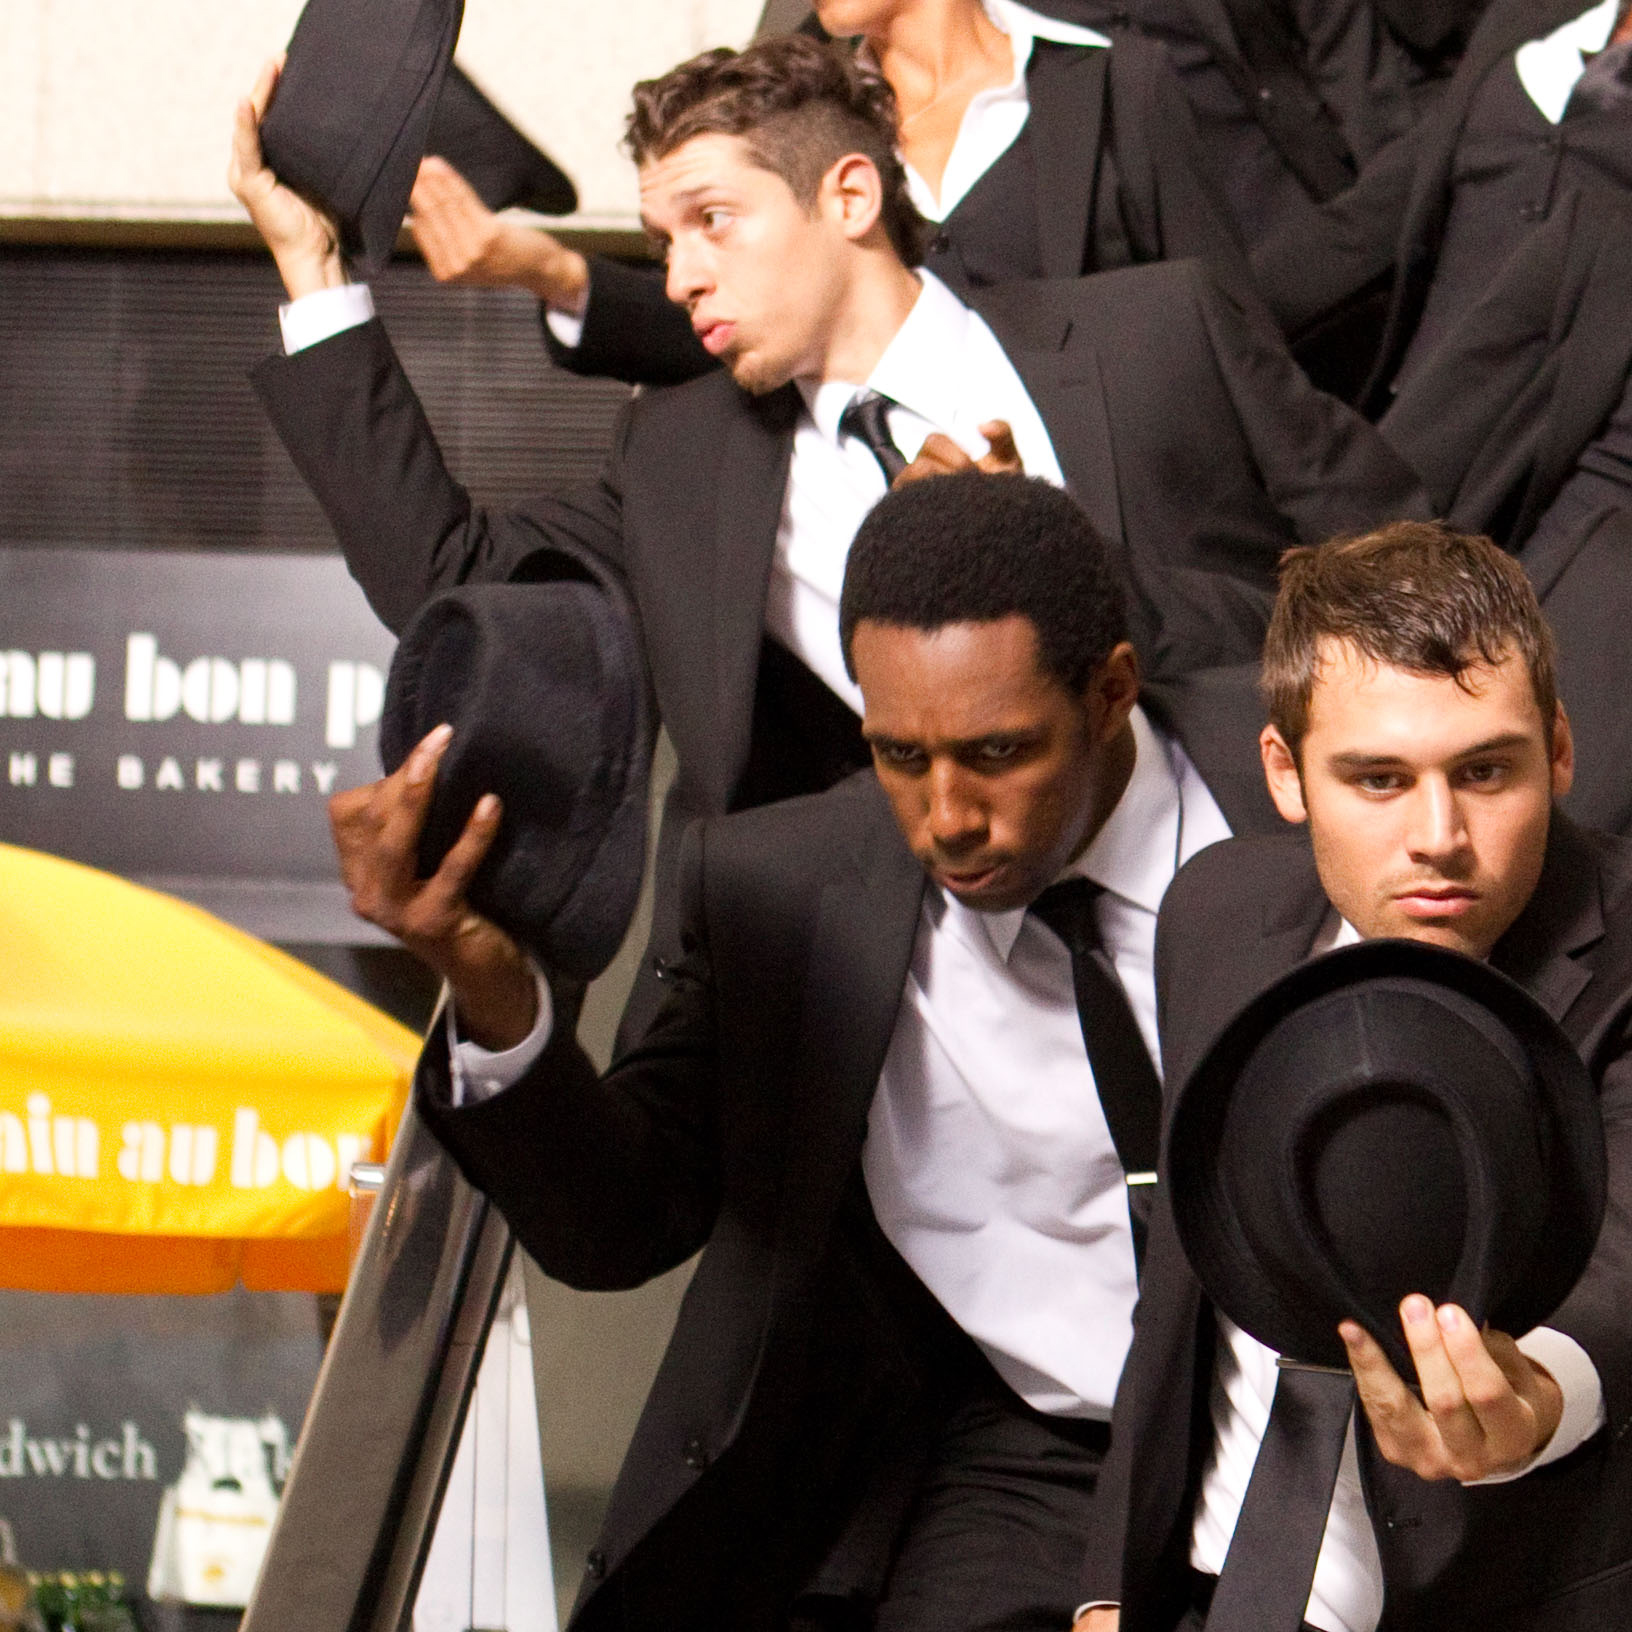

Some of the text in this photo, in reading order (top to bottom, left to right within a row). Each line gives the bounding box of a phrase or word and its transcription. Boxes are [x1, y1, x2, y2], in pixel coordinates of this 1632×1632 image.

[125, 632, 296, 725] bon
[117, 754, 337, 795] BAKERY
[117, 1121, 218, 1186] au
